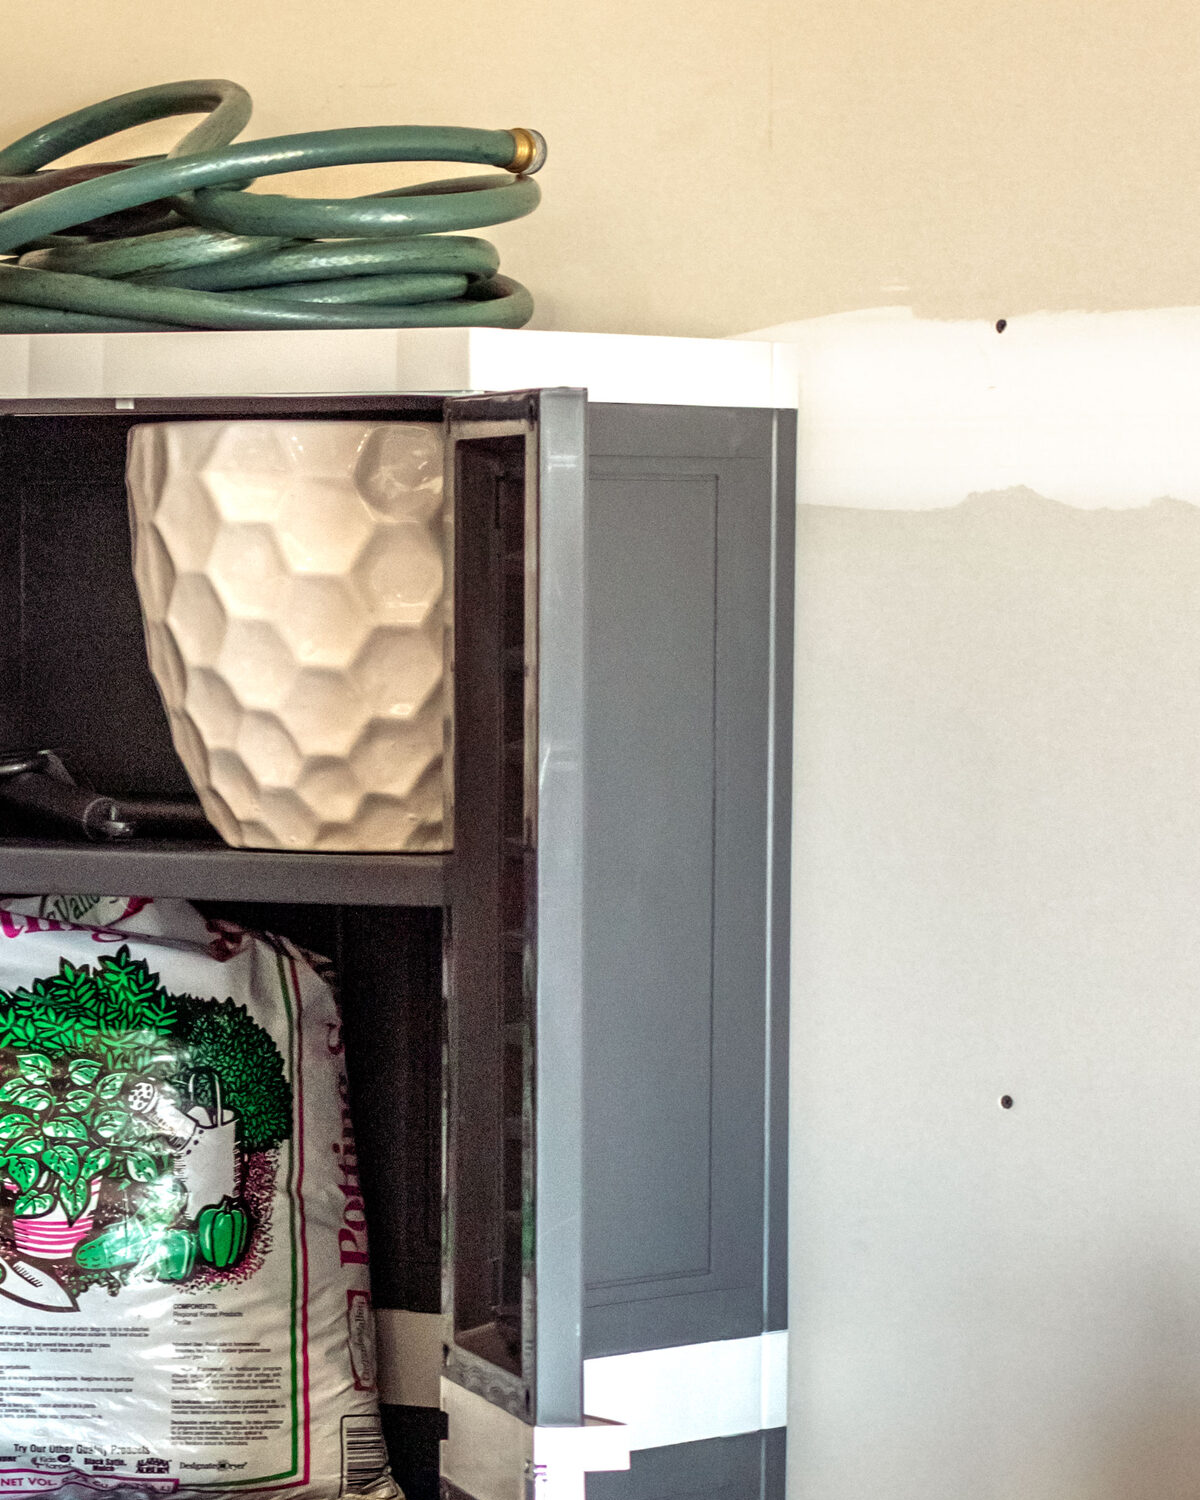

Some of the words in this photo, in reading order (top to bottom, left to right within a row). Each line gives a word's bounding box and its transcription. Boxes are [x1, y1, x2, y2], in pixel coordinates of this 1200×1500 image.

[13, 1444, 27, 1453] Try
[30, 1444, 46, 1453] Our
[49, 1445, 73, 1453] Other
[0, 1478, 24, 1487] NET
